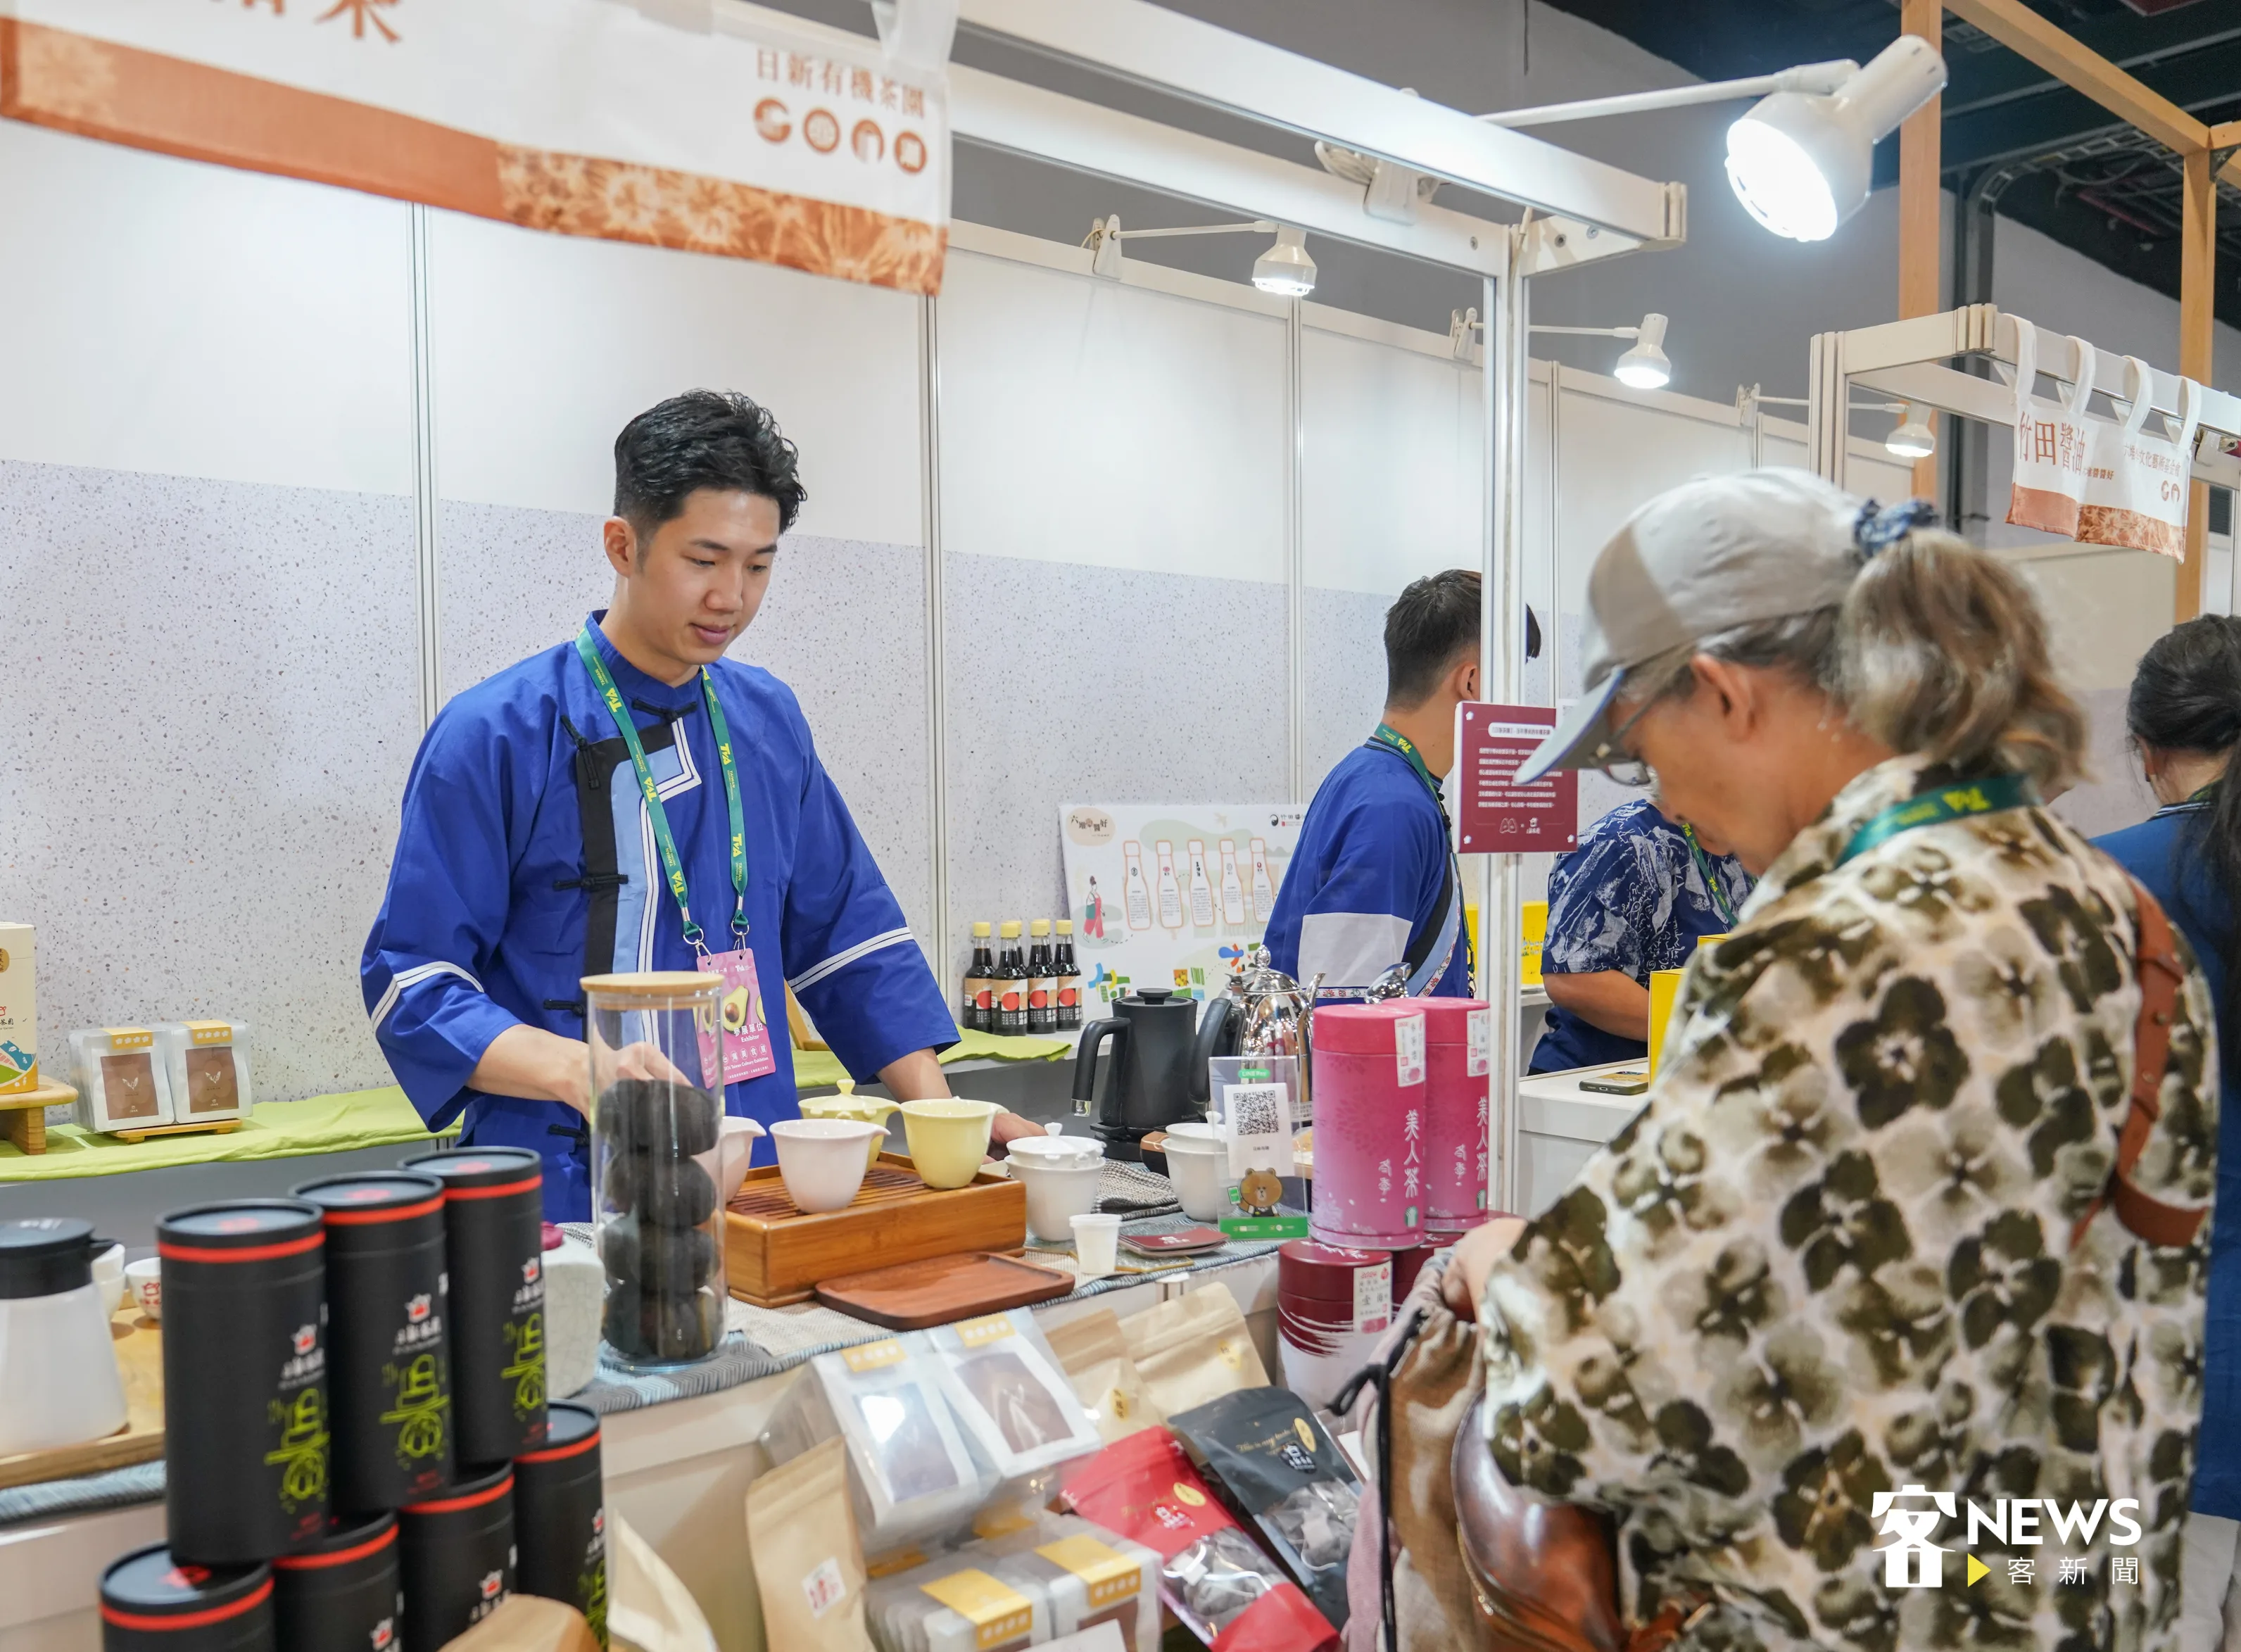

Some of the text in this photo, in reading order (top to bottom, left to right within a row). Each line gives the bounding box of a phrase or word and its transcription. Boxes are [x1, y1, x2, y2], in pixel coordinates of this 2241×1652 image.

[757, 49, 925, 120] 日新有機茶園
[665, 847, 674, 867] TAIWAN
[733, 1022, 764, 1037] 參展單位
[1403, 1109, 1420, 1199] 美人茶
[1475, 1096, 1488, 1182] 美人茶
